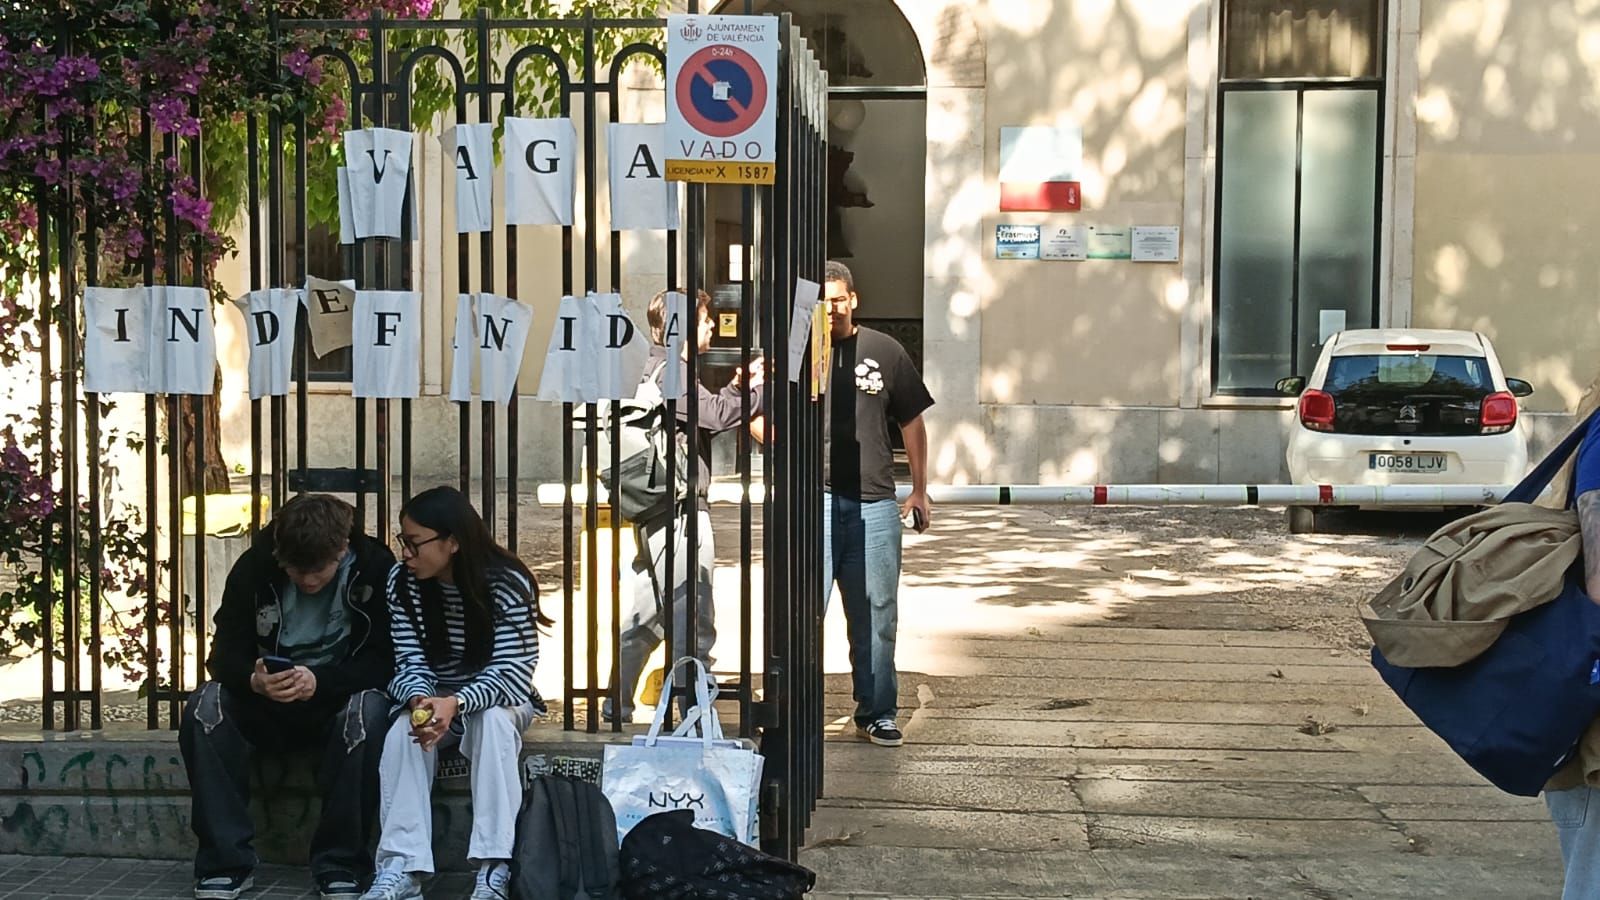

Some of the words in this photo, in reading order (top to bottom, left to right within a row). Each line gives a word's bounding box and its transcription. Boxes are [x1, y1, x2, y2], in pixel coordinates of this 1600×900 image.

[706, 24, 765, 32] AJUNTAMENT
[711, 47, 734, 56] 0-24h
[680, 140, 762, 159] VADO
[667, 166, 704, 175] LICENCIA
[716, 166, 726, 178] X
[738, 167, 769, 179] 1587
[1378, 455, 1413, 468] 0058
[1417, 456, 1443, 469] LJV
[648, 791, 704, 809] NYX
